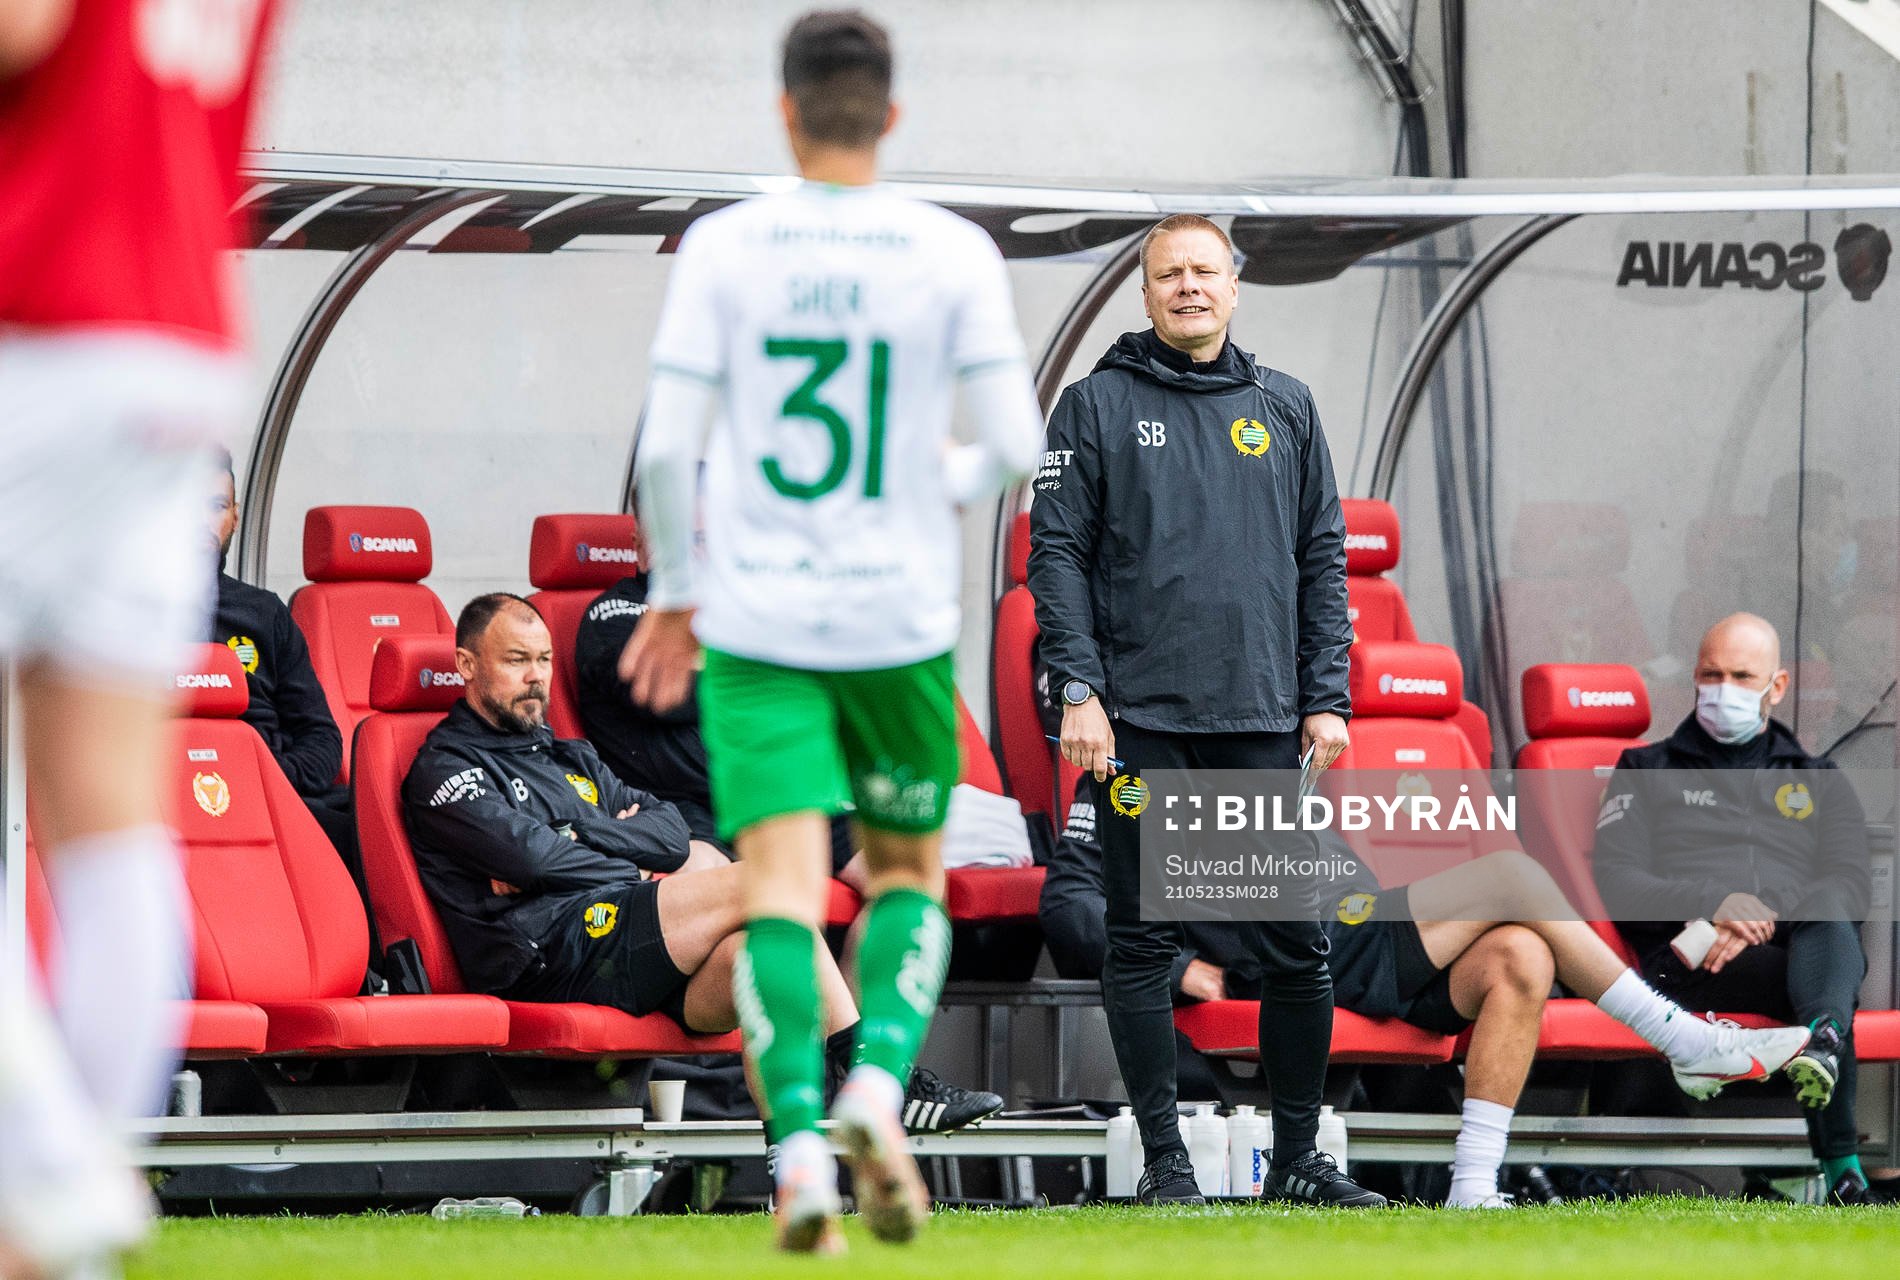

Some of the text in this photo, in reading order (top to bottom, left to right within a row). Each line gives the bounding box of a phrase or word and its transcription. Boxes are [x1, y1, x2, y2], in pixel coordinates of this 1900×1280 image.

[760, 338, 891, 501] 31
[1137, 420, 1167, 447] SB
[363, 537, 419, 553] SCANIA
[176, 673, 233, 688] SCANIA
[1391, 678, 1448, 695] SCANIA
[1581, 691, 1636, 706] SCANIA
